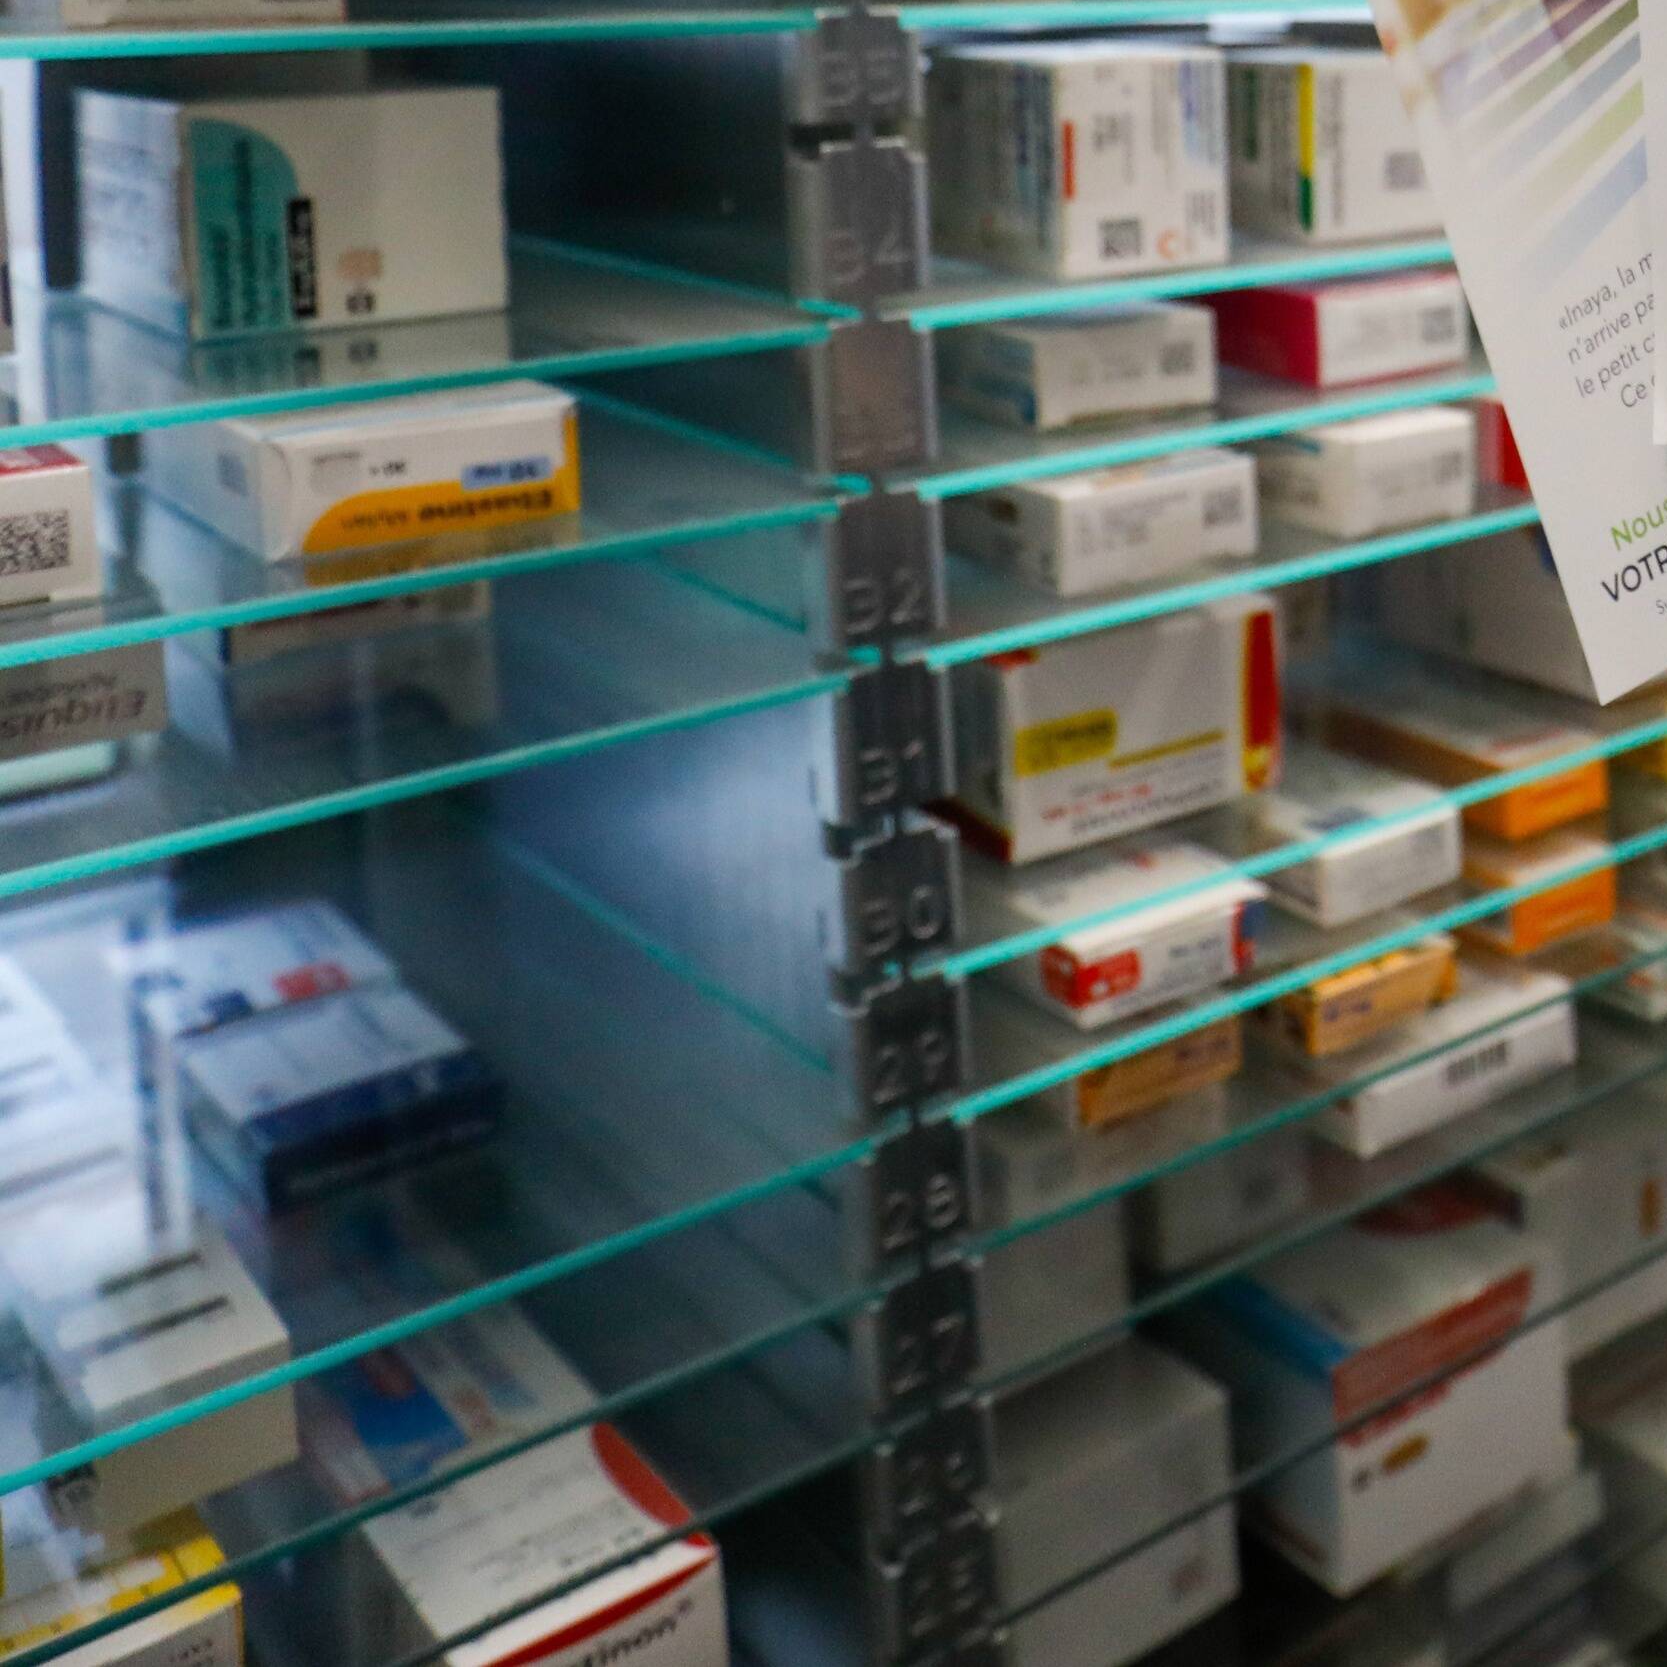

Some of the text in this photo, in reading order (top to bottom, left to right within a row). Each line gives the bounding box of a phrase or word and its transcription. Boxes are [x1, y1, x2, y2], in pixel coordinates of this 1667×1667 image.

[1559, 285, 1617, 330] «Inaya,
[1616, 266, 1636, 287] la
[1568, 293, 1654, 365] n'arrive pa
[1575, 376, 1595, 398] le
[1598, 344, 1641, 391] petit
[1621, 384, 1647, 408] Ce
